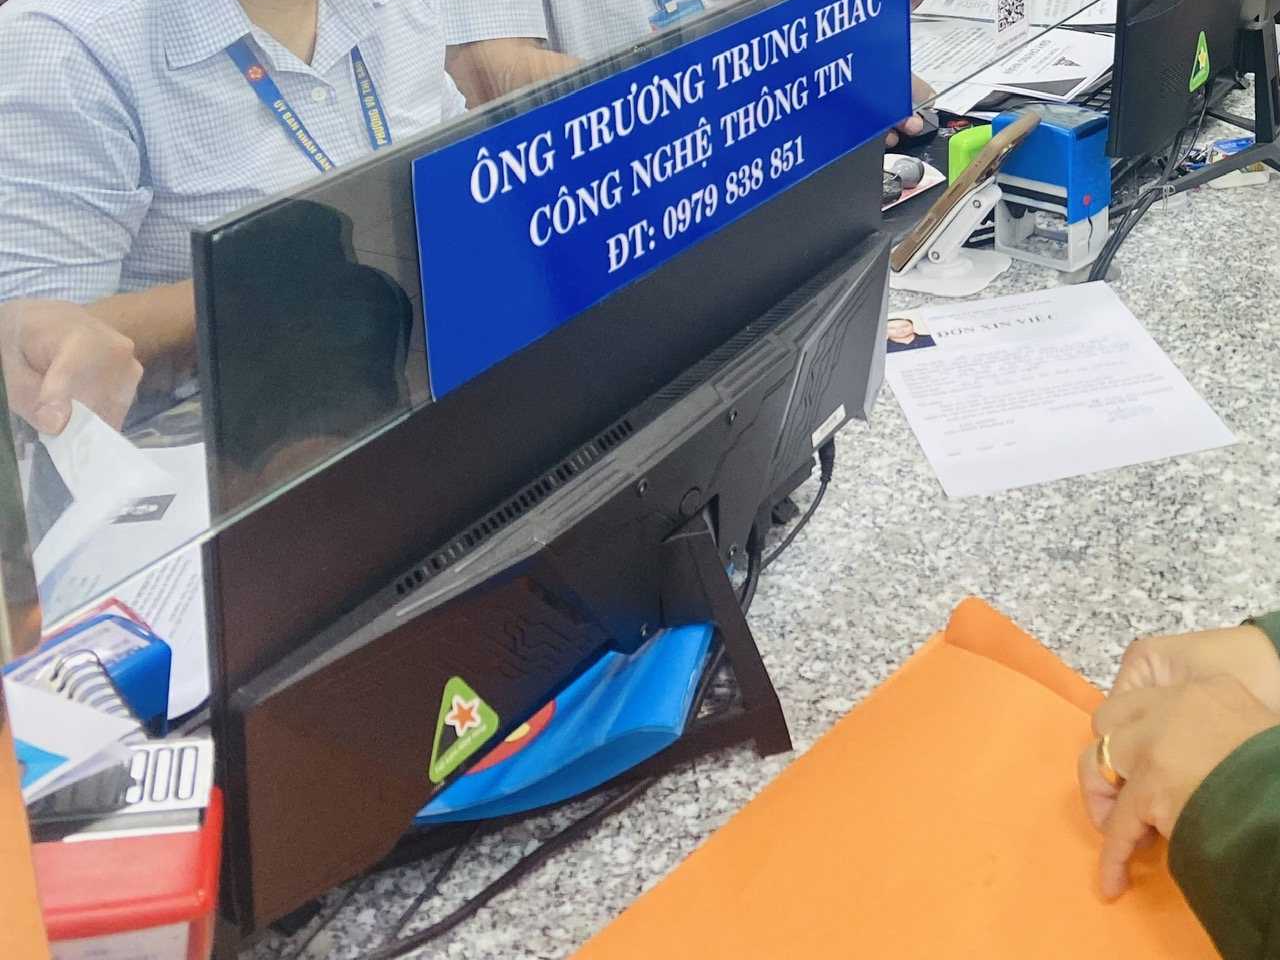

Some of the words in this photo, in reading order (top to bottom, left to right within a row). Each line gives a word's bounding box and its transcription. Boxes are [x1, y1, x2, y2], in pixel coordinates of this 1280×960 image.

[470, 146, 556, 204] ÔNG
[565, 62, 704, 160] TRƯƠNG
[712, 16, 808, 90] TRUNG
[529, 169, 623, 247] CÔNG
[630, 116, 713, 197] NGHỆ
[720, 76, 809, 148] THÔNG
[814, 53, 854, 99] TIN
[606, 219, 655, 274] ĐT:
[662, 183, 718, 240] 0979
[725, 158, 764, 205] 838
[770, 135, 805, 180] 851
